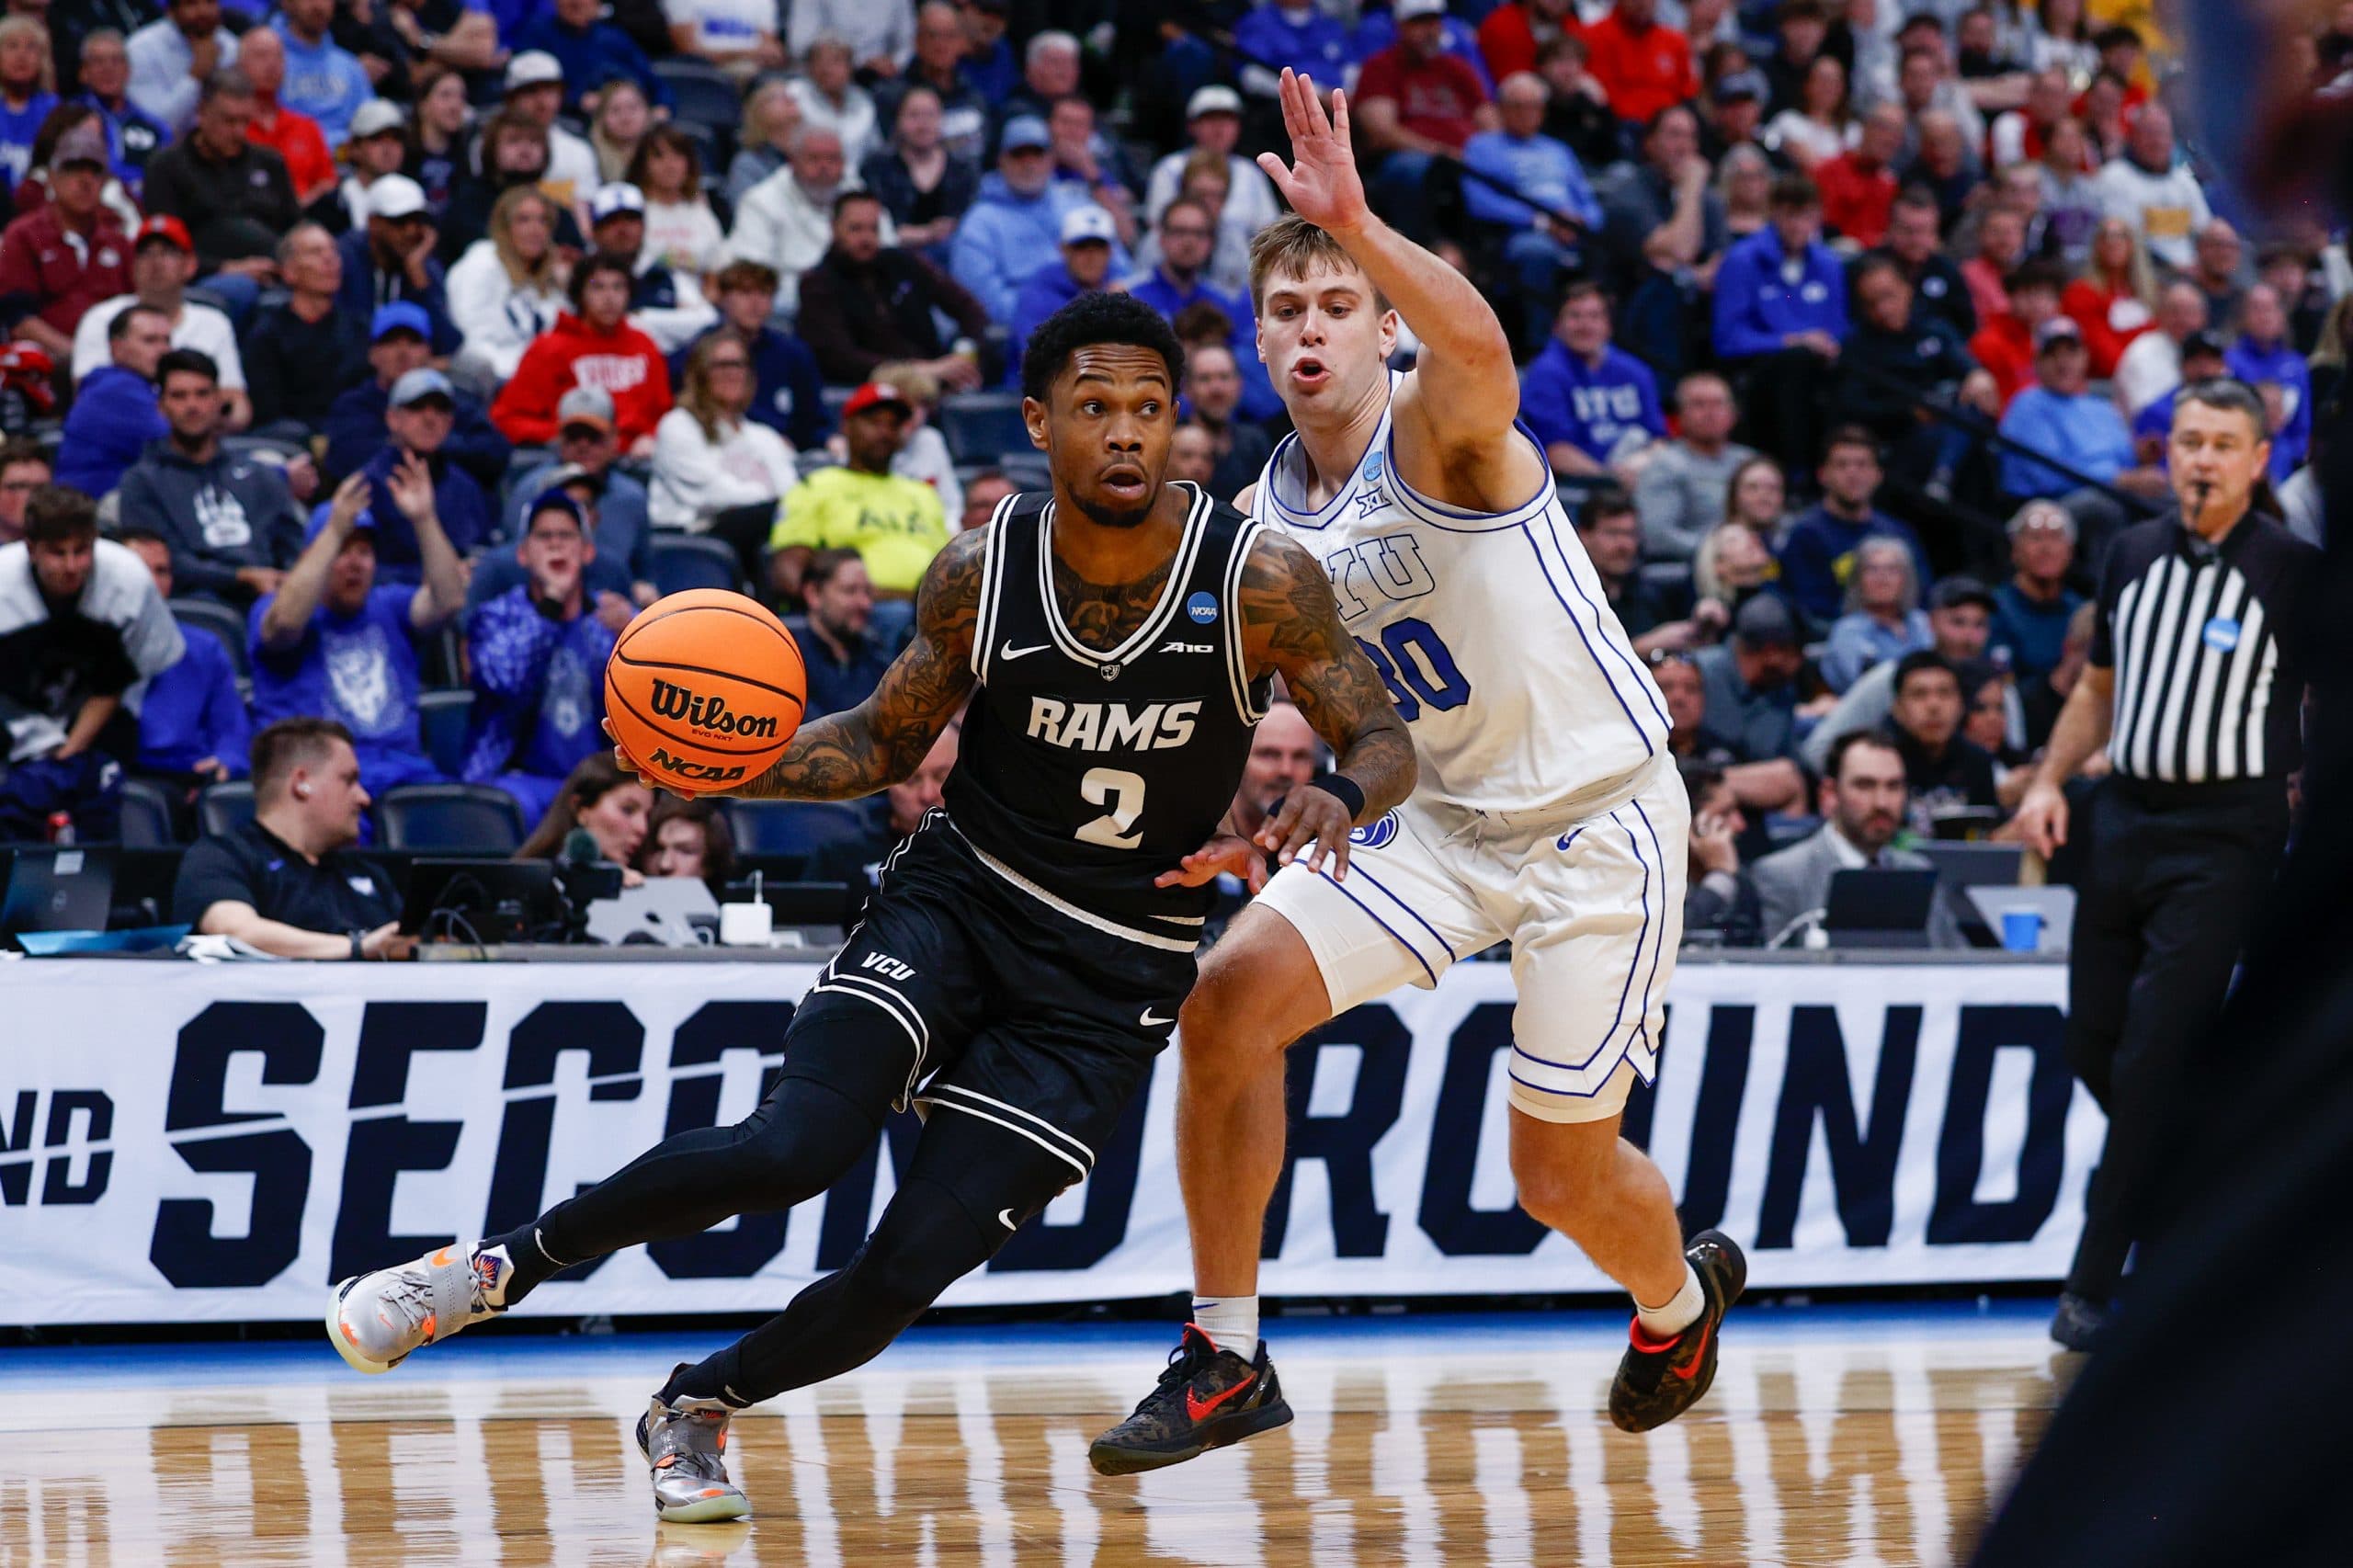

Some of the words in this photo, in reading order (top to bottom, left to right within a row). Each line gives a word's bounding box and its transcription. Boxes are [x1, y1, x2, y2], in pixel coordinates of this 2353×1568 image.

[1318, 534, 1436, 621] YU
[1190, 606, 1219, 617] NCAA
[1157, 642, 1214, 653] A10
[651, 677, 777, 738] Wilson
[1026, 696, 1203, 752] RAMS
[691, 729, 711, 738] EVO
[649, 747, 747, 782] NCAA
[1074, 767, 1146, 849] 2
[860, 951, 916, 982] VCU
